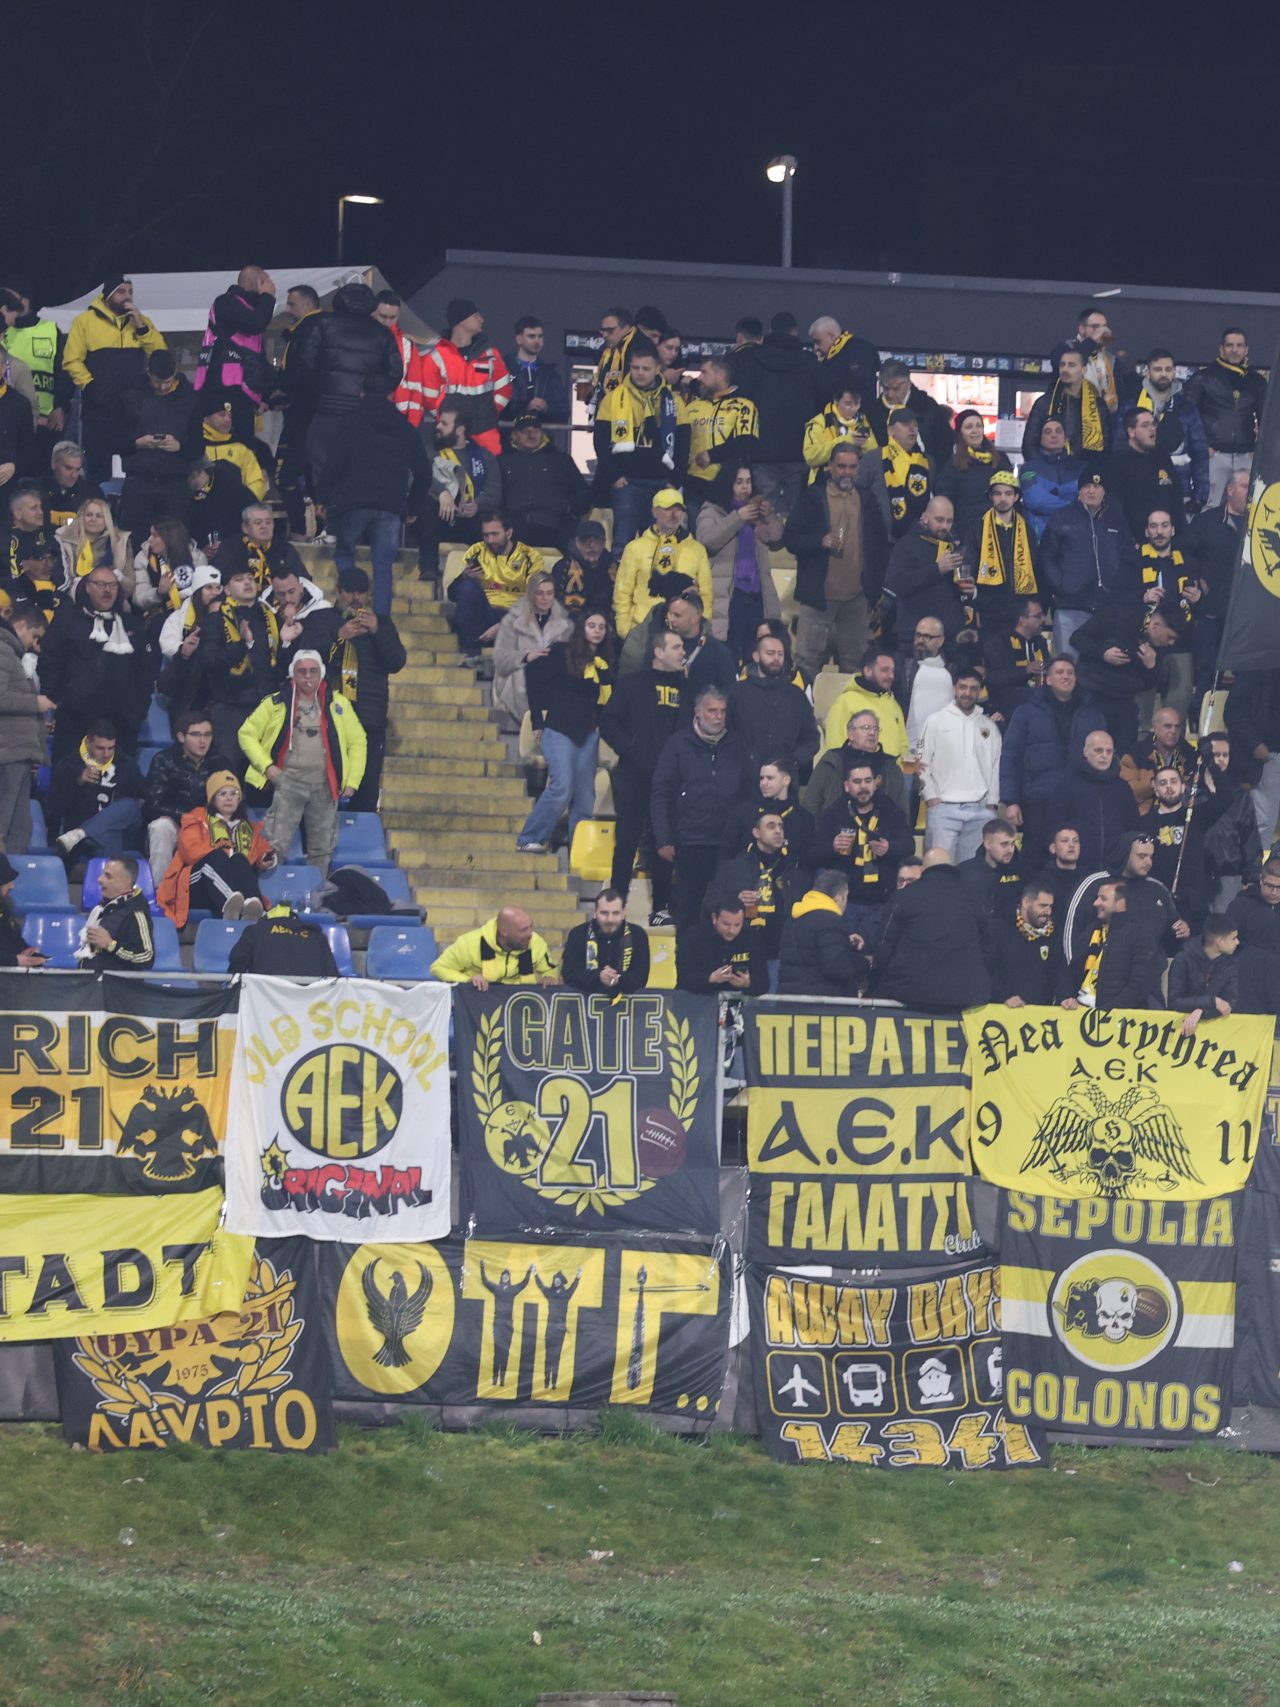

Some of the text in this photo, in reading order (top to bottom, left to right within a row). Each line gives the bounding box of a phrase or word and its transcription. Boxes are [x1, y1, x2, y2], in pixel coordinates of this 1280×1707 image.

[0, 1013, 219, 1080] RICH
[245, 1000, 448, 1093] OLD SCHOOL
[504, 992, 664, 1075] GATE
[977, 1019, 1064, 1077] Nea
[9, 1086, 104, 1150] 21
[285, 1044, 398, 1158] AEK
[535, 1072, 642, 1191] 21
[976, 1100, 1003, 1148] 9
[944, 1230, 984, 1256] Club
[1007, 1189, 1236, 1248] SEPOLIA
[95, 1300, 285, 1358] ΘΥΡΑ 21
[764, 1274, 898, 1348] AWAY
[88, 1389, 317, 1451] ΛΑΥΡΙΟ
[1007, 1367, 1222, 1433] COLONOS
[780, 1410, 1043, 1468] 14341
